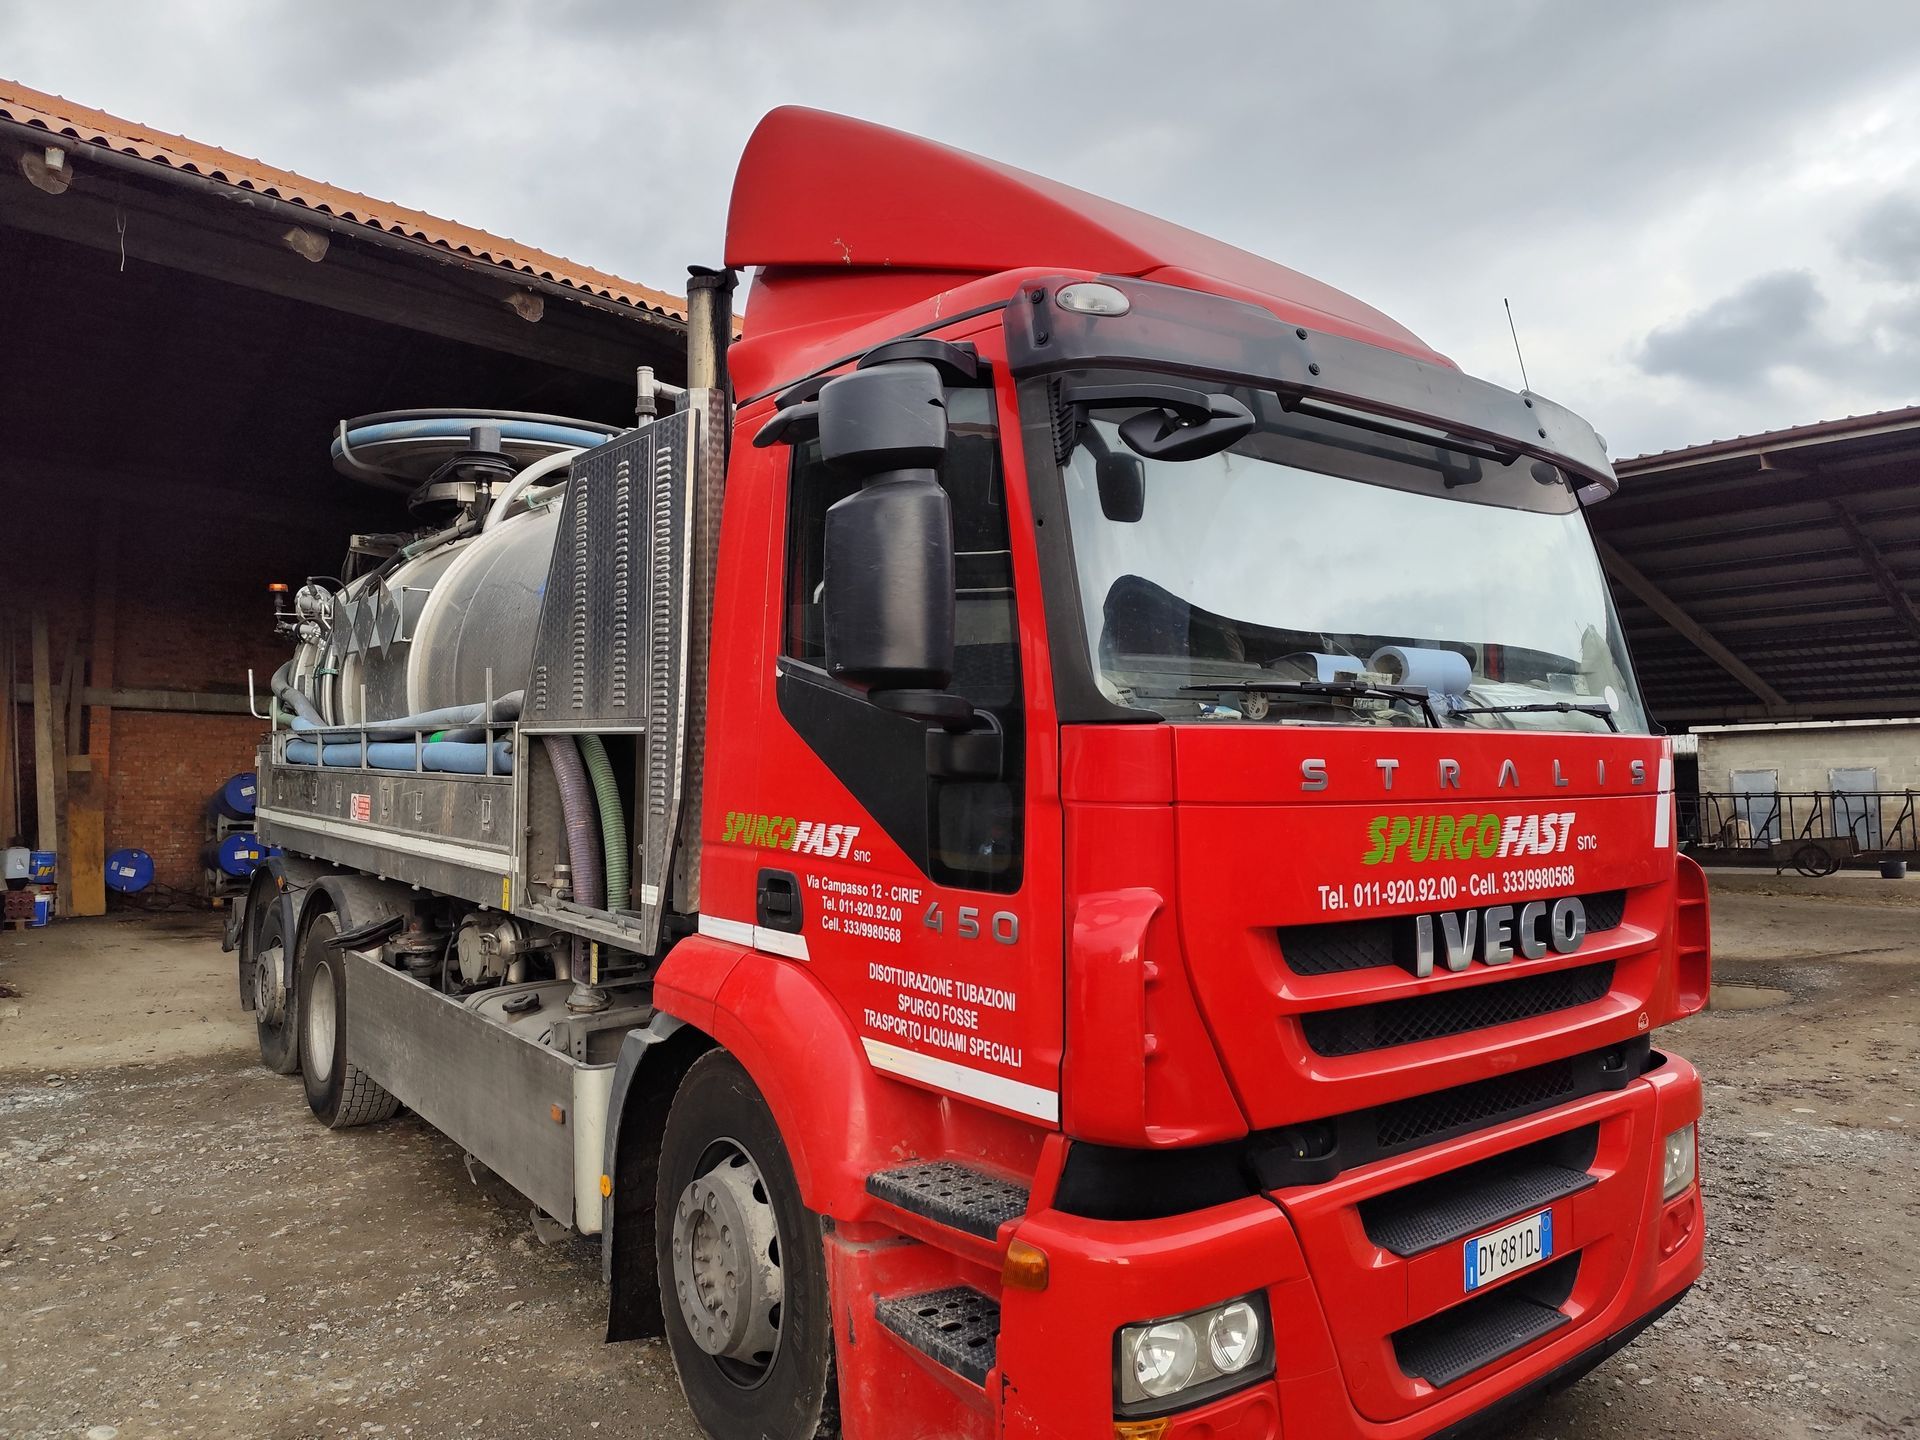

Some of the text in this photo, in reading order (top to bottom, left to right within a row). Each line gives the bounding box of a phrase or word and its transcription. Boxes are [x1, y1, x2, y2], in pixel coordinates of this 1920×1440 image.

[1301, 758, 1646, 791] STRALIS
[722, 811, 872, 863] SPURGOFAST snc
[1360, 812, 1598, 865] SPURGOFAST snc
[806, 874, 820, 888] Via
[822, 876, 868, 897] Campasso
[871, 885, 882, 899] 12
[891, 886, 923, 905] CIRIE'
[822, 896, 902, 923] Tel. 011-920.92.00
[1318, 882, 1349, 911] Tel.
[1353, 877, 1457, 908] 011-920.92.00
[1469, 872, 1500, 898] Cell.
[1503, 865, 1575, 893] 333/9980568
[822, 915, 902, 944] Cell. 333/9980568
[922, 902, 1020, 945] 450
[1415, 896, 1588, 978] IVECO
[869, 962, 1016, 1012] DISOTTURAZIONE TUBAZIONI
[898, 993, 979, 1030] SPURGO FOSSE
[864, 1008, 1022, 1068] TRASPORTO LIQUAMI SPECIALI
